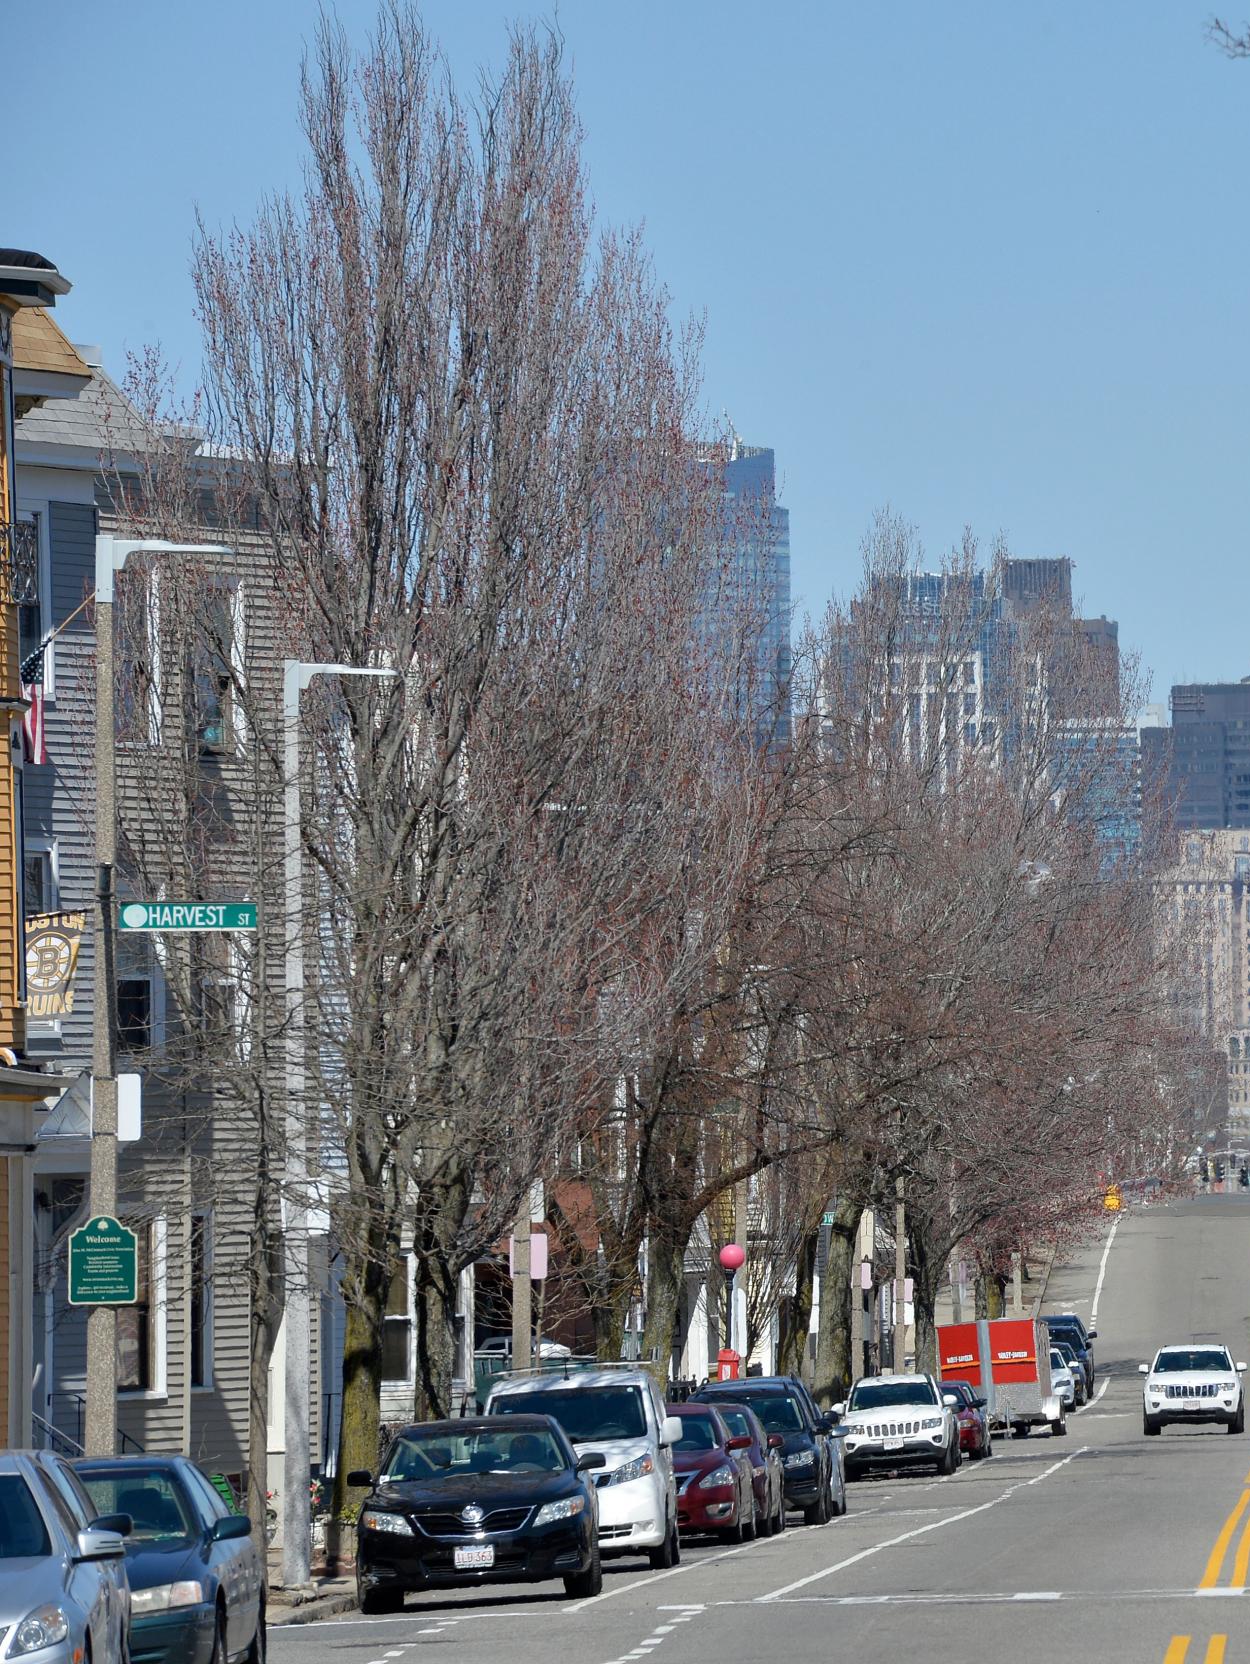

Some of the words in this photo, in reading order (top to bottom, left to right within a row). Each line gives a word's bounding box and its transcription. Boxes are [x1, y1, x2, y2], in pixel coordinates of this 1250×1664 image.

[148, 905, 227, 926] HARVEST
[237, 913, 250, 926] ST
[26, 991, 74, 1016] RUINS
[85, 1235, 121, 1244] Welcome
